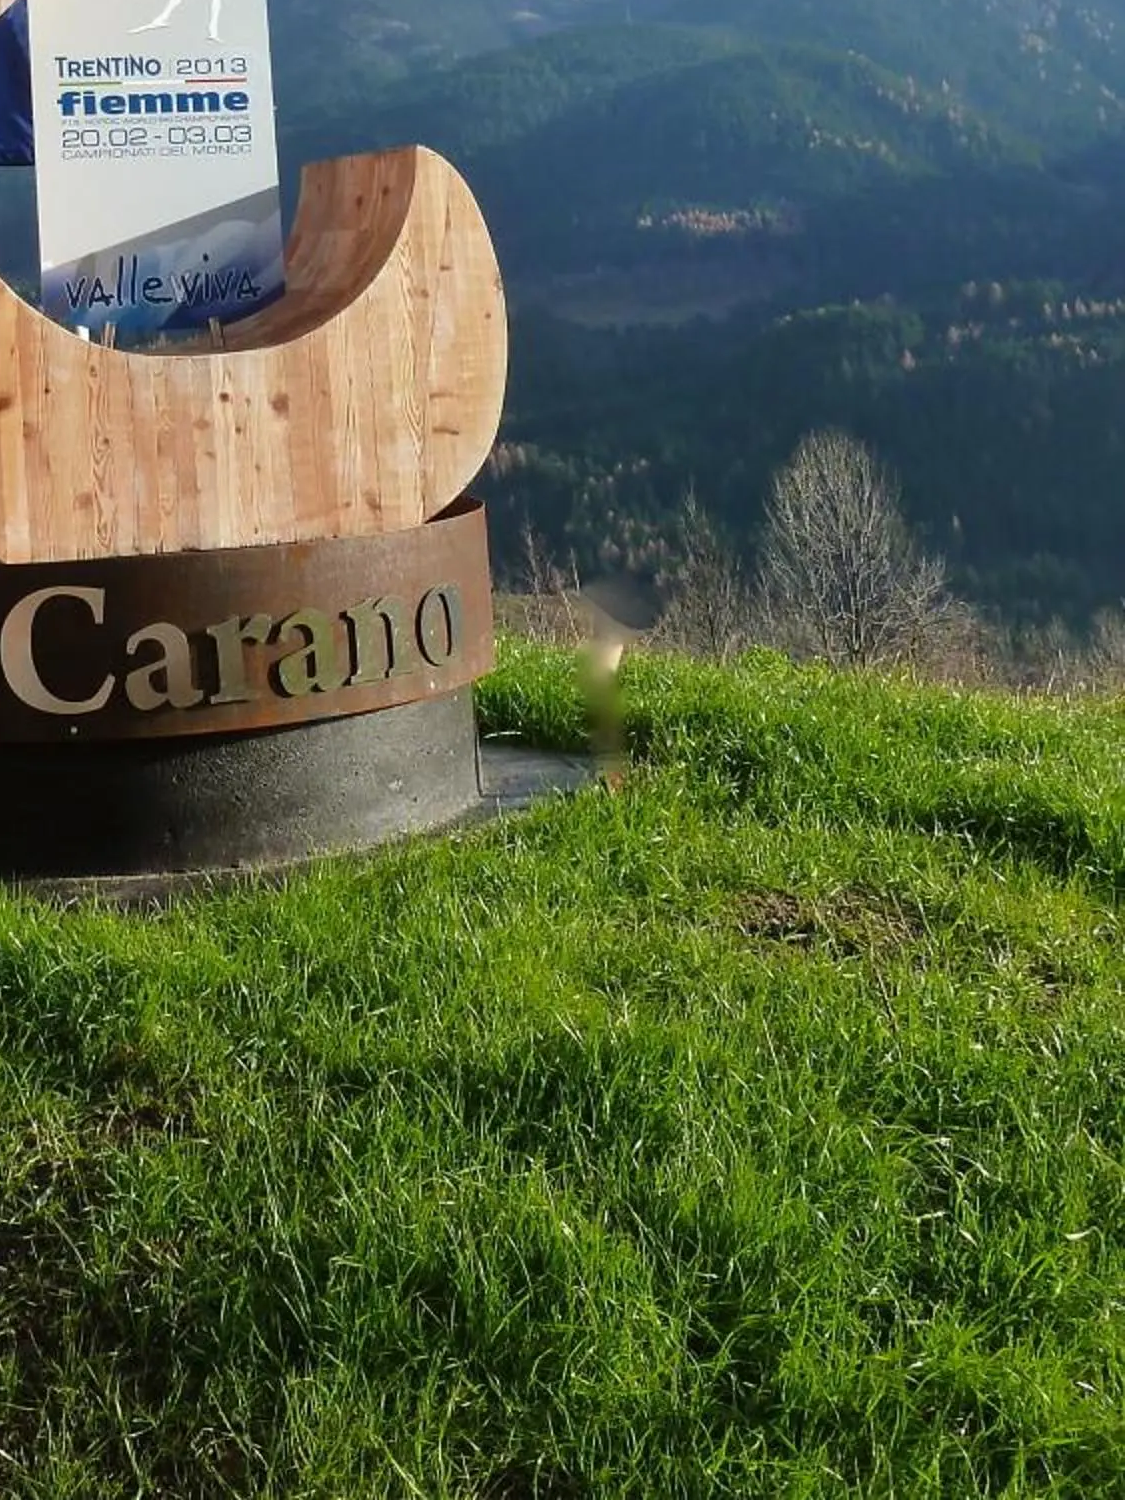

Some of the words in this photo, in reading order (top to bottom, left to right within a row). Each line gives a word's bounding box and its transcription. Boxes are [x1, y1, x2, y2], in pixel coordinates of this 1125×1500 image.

[55, 55, 162, 78] TRENTINO
[176, 57, 248, 75] 2013
[57, 90, 250, 116] fiemme
[62, 127, 148, 148] 20.02
[168, 125, 252, 144] 03.03
